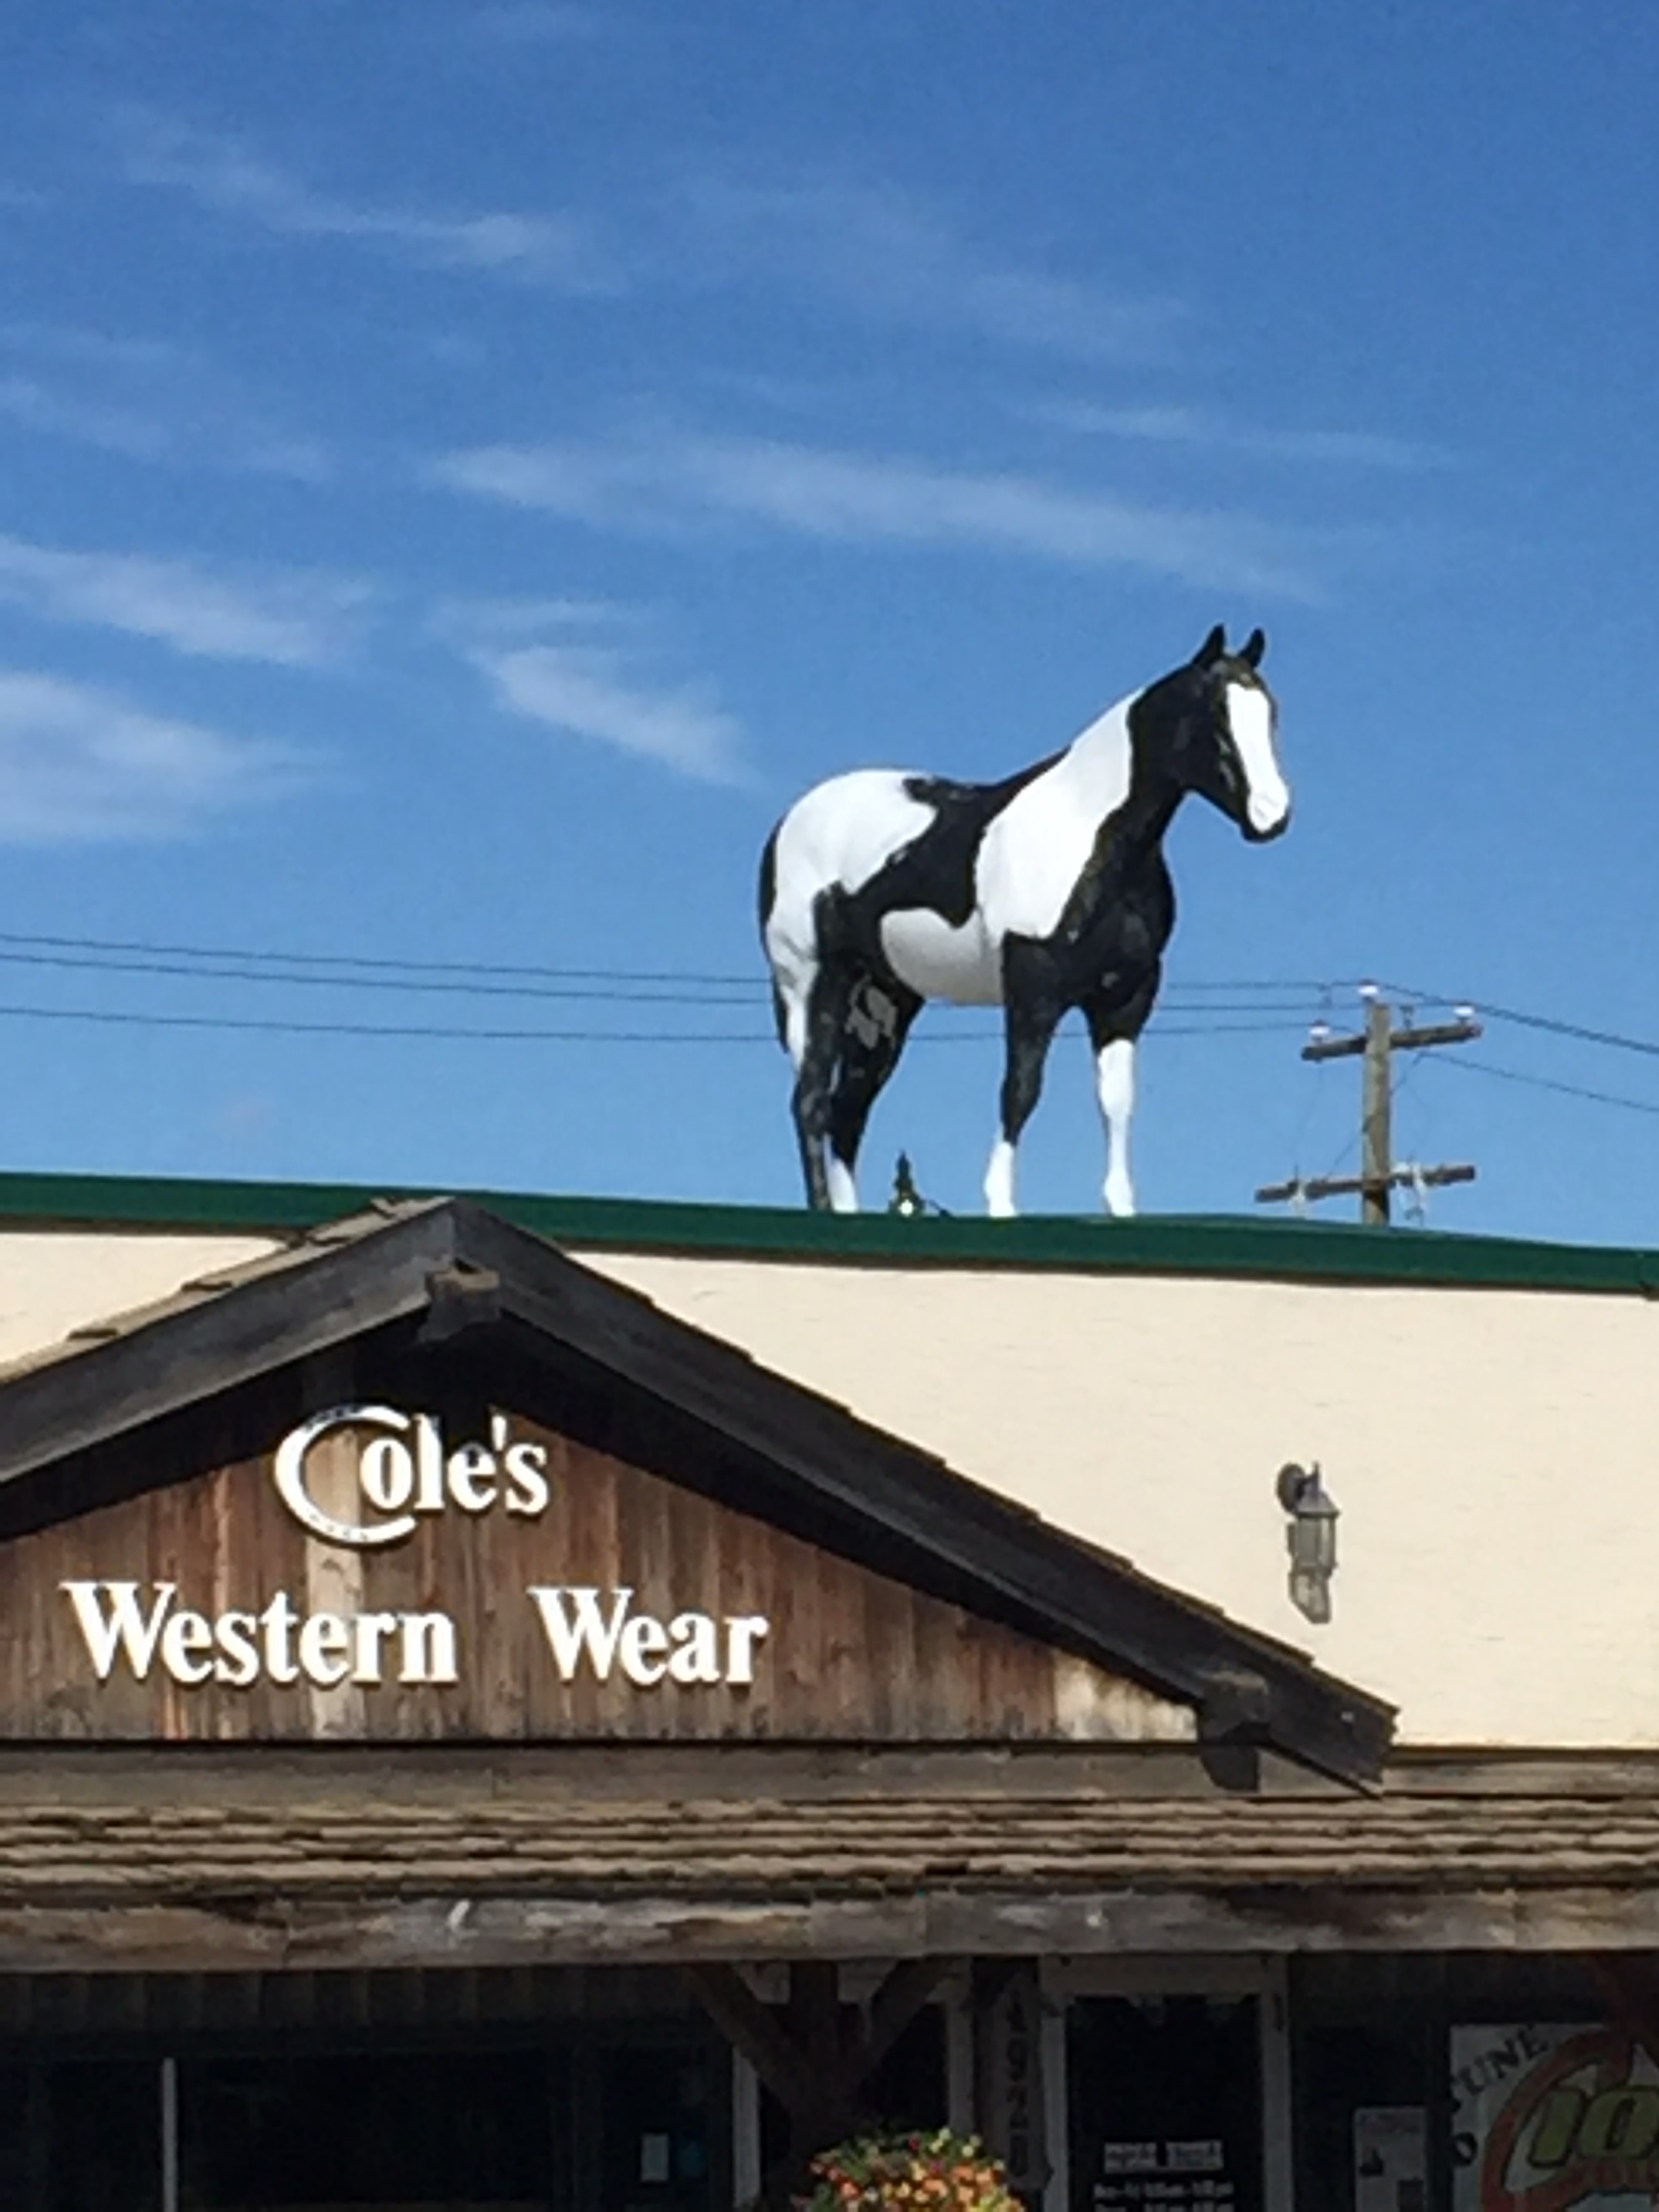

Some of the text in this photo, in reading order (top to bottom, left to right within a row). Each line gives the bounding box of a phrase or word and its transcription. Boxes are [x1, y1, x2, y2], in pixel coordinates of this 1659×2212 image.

[274, 1405, 548, 1544] Cole's
[60, 1580, 769, 1685] Western Wear
